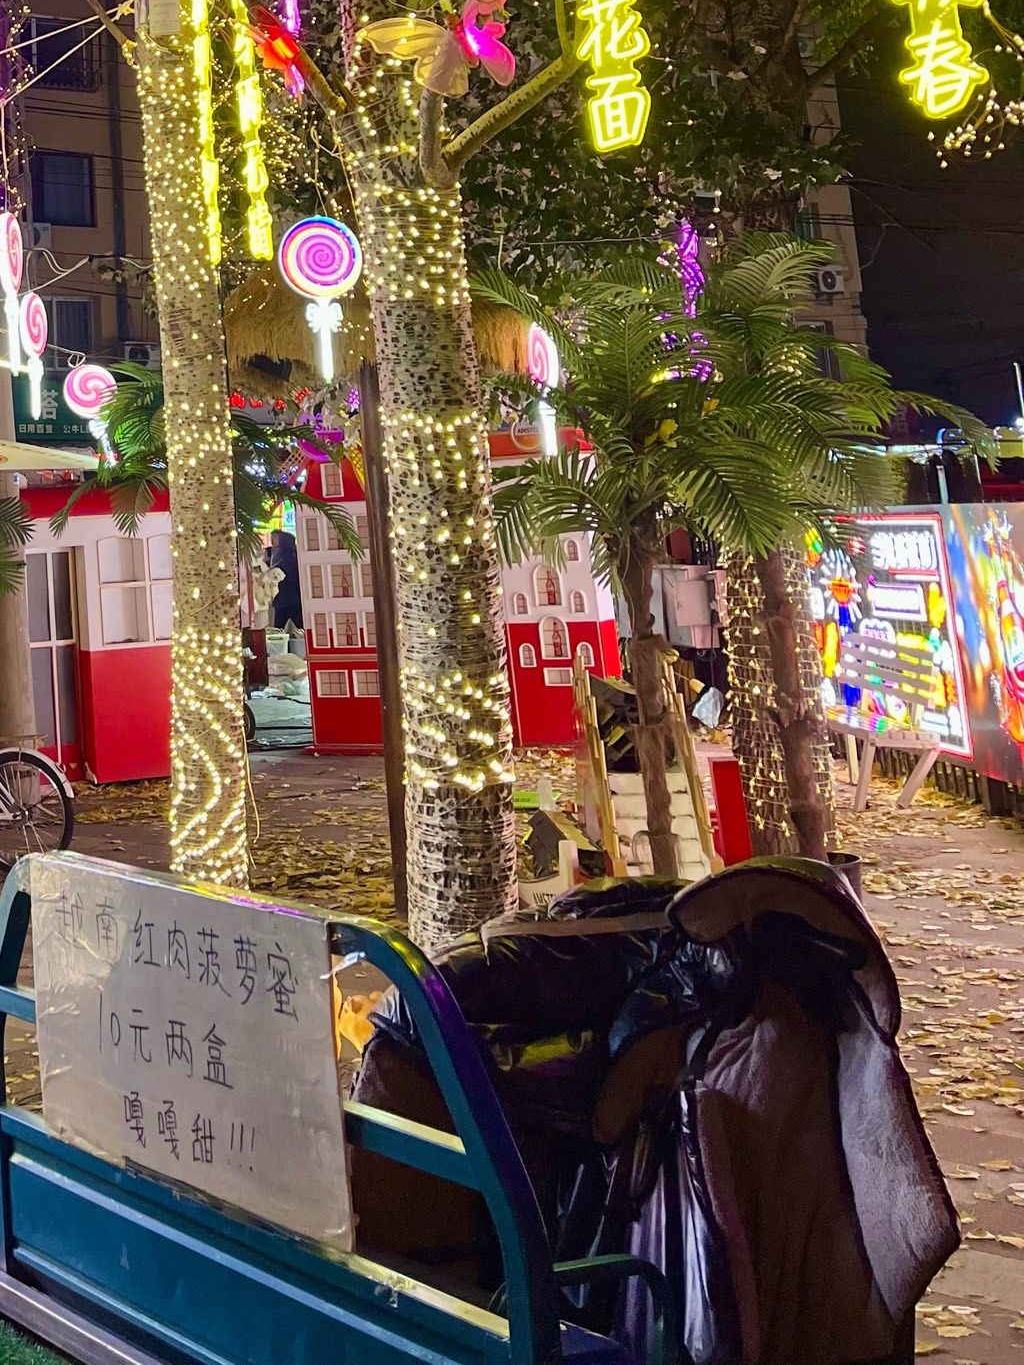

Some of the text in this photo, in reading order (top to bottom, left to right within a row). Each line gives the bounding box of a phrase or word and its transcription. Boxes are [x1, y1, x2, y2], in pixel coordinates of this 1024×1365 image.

[55, 890, 300, 1023] 越南红肉菠萝蜜
[98, 988, 234, 1090] 10元两盒
